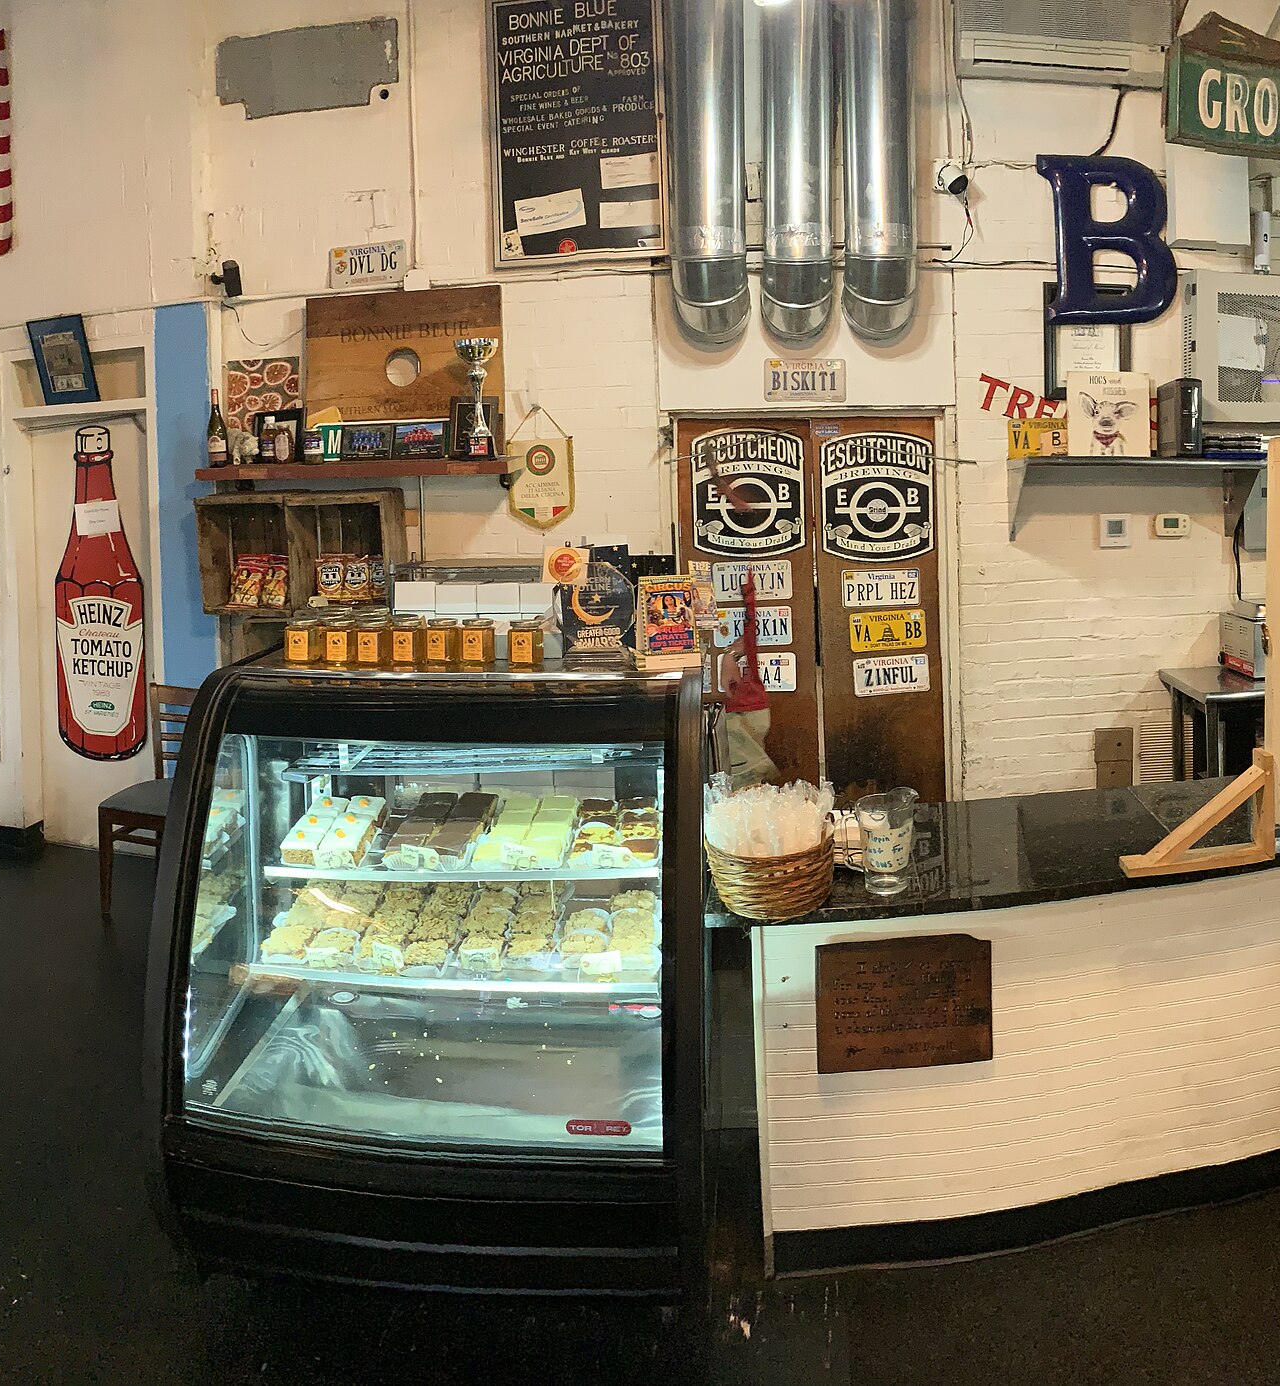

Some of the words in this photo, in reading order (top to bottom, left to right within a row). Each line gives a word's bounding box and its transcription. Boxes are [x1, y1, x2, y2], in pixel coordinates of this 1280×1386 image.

[508, 8, 564, 31] BONNIE
[574, 0, 618, 19] BLUE
[501, 31, 551, 46] SOUTHERN
[498, 45, 564, 67] VIRGINIA
[570, 35, 609, 57] DEPT
[619, 34, 639, 51] OF
[501, 54, 604, 84] AGRICULTURE
[621, 51, 651, 69] 803
[510, 91, 542, 102] SPECIAL
[520, 101, 537, 112] FINE
[538, 99, 561, 110] WINES
[502, 115, 545, 126] WHOLESALE
[612, 101, 655, 113] PRODUCE
[502, 125, 534, 134] SPECIAL
[538, 121, 559, 130] EVENT
[503, 143, 565, 157] WINCHESTER
[570, 136, 608, 148] COFFEE
[612, 134, 658, 147] ROASTERS
[1037, 155, 1178, 325] B
[350, 245, 386, 256] VIRGINIA
[350, 254, 375, 276] DVL
[381, 251, 397, 272] DG
[340, 323, 414, 344] BONNIE
[419, 321, 470, 338] BLUE
[785, 362, 824, 370] VIRGINIA
[1089, 376, 1107, 384] HOGS
[1012, 431, 1030, 450] VA
[826, 437, 929, 473] ESCUTCHEON
[778, 483, 790, 501] B
[836, 488, 848, 506] E
[907, 488, 920, 505] B
[712, 534, 736, 546] Mind
[738, 536, 763, 547] Your
[765, 533, 789, 546] Draft
[840, 539, 865, 551] Mind
[866, 540, 892, 551] Your
[893, 538, 917, 549] Draft
[645, 582, 691, 592] CIRCUS
[847, 583, 883, 601] PRPL
[890, 582, 916, 599] HEZ
[77, 603, 125, 628] HEINZ
[869, 614, 905, 622] VIRGINIA
[78, 628, 120, 638] Chateau
[577, 628, 603, 638] GREATER
[655, 633, 689, 641] GRATIS
[854, 625, 871, 642] VA
[905, 621, 922, 639] BB
[71, 638, 132, 658] TOMATO
[72, 658, 133, 678] KETCHUP
[872, 658, 908, 666] VIRGINIA
[864, 666, 917, 687] ZINFUL
